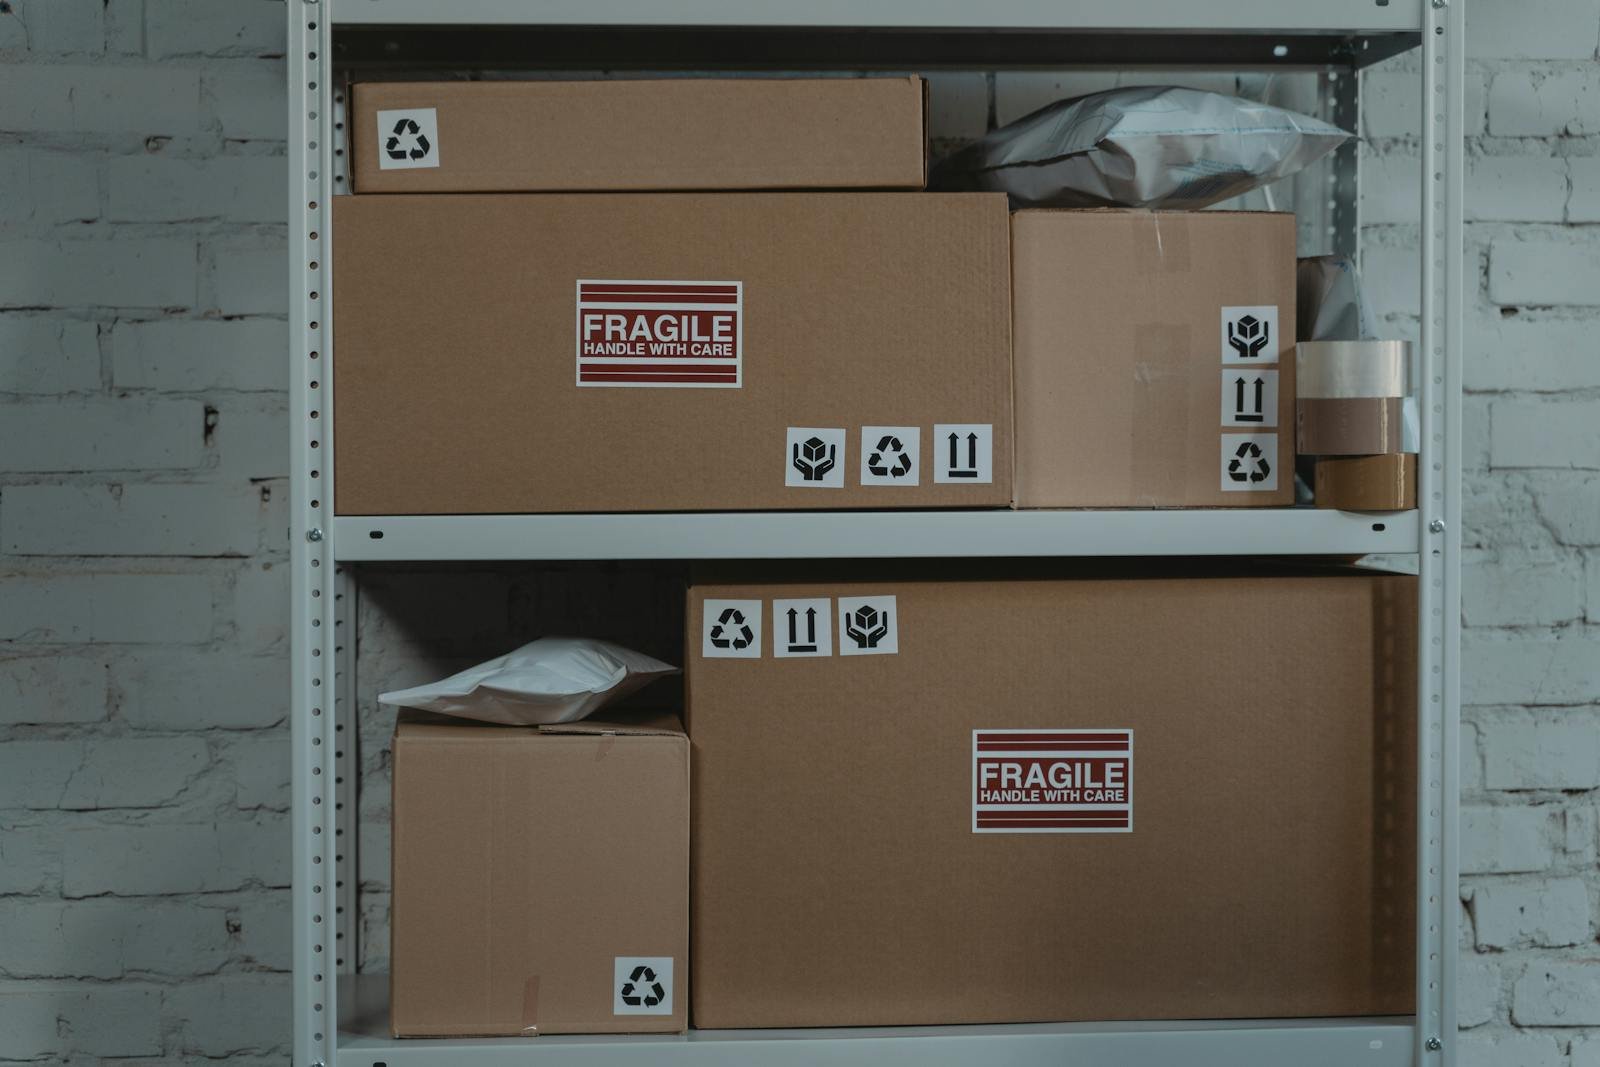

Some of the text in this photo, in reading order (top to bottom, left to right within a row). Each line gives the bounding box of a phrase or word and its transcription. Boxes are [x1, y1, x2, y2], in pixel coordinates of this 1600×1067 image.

[583, 314, 733, 342] FRAGILE
[584, 343, 733, 356] HANDLE WITH CARE
[980, 762, 1125, 788] FRAGILE
[980, 789, 1125, 801] HANDLE WITH CARE
